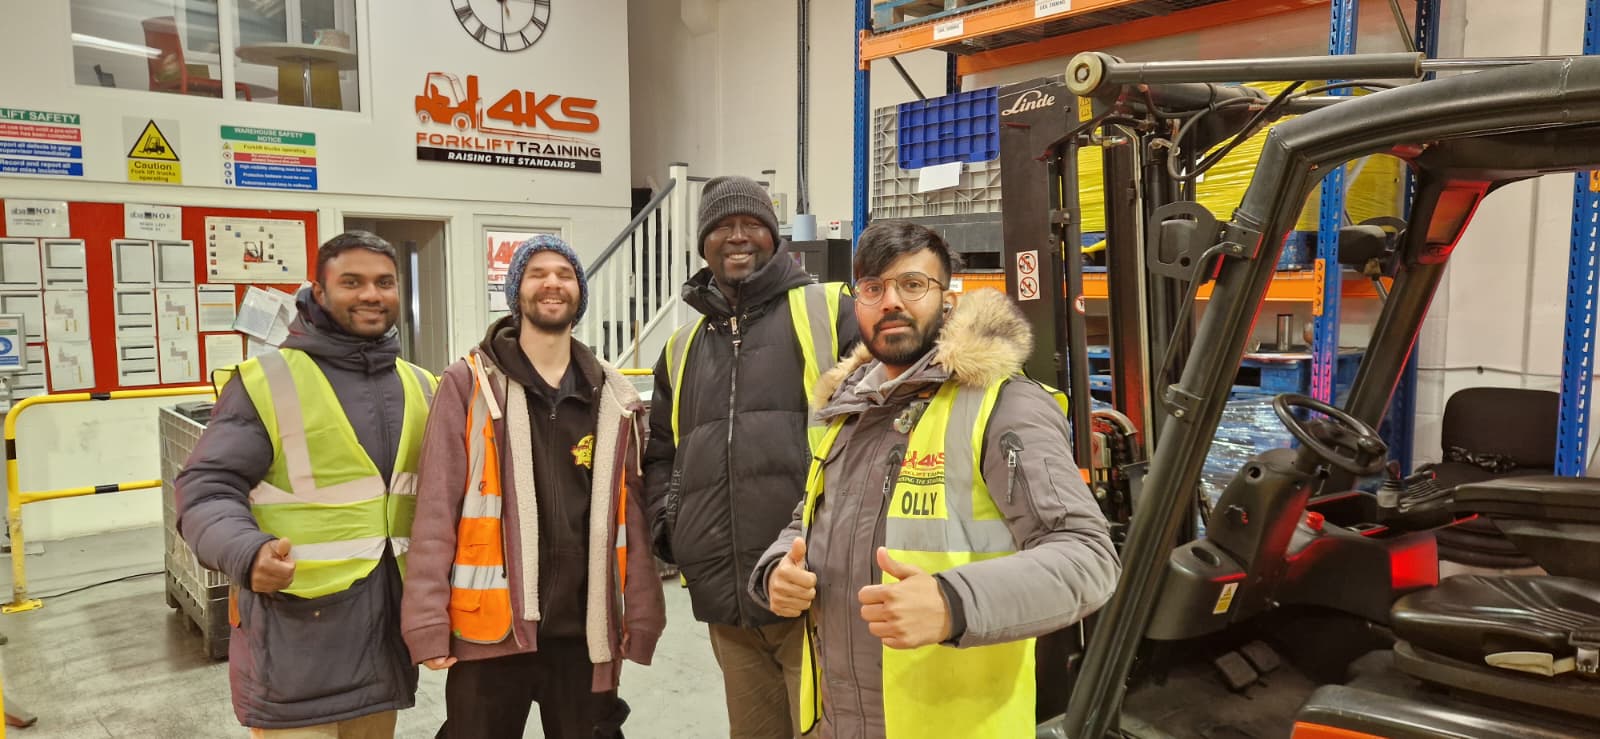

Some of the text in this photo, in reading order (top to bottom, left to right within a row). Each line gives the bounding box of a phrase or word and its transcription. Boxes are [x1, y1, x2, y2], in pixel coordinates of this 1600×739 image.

[486, 89, 600, 133] 4KS
[1001, 90, 1056, 116] Linde
[0, 109, 77, 123] LIFT SAFETY
[233, 127, 303, 138] WAREHOUSE SAFETY
[257, 135, 282, 143] NOTICE
[416, 132, 601, 158] FORKLIFT TRAINING
[134, 160, 172, 170] Caution
[447, 152, 577, 169] RAISING THE STANDARDS
[902, 490, 937, 516] OLLY
